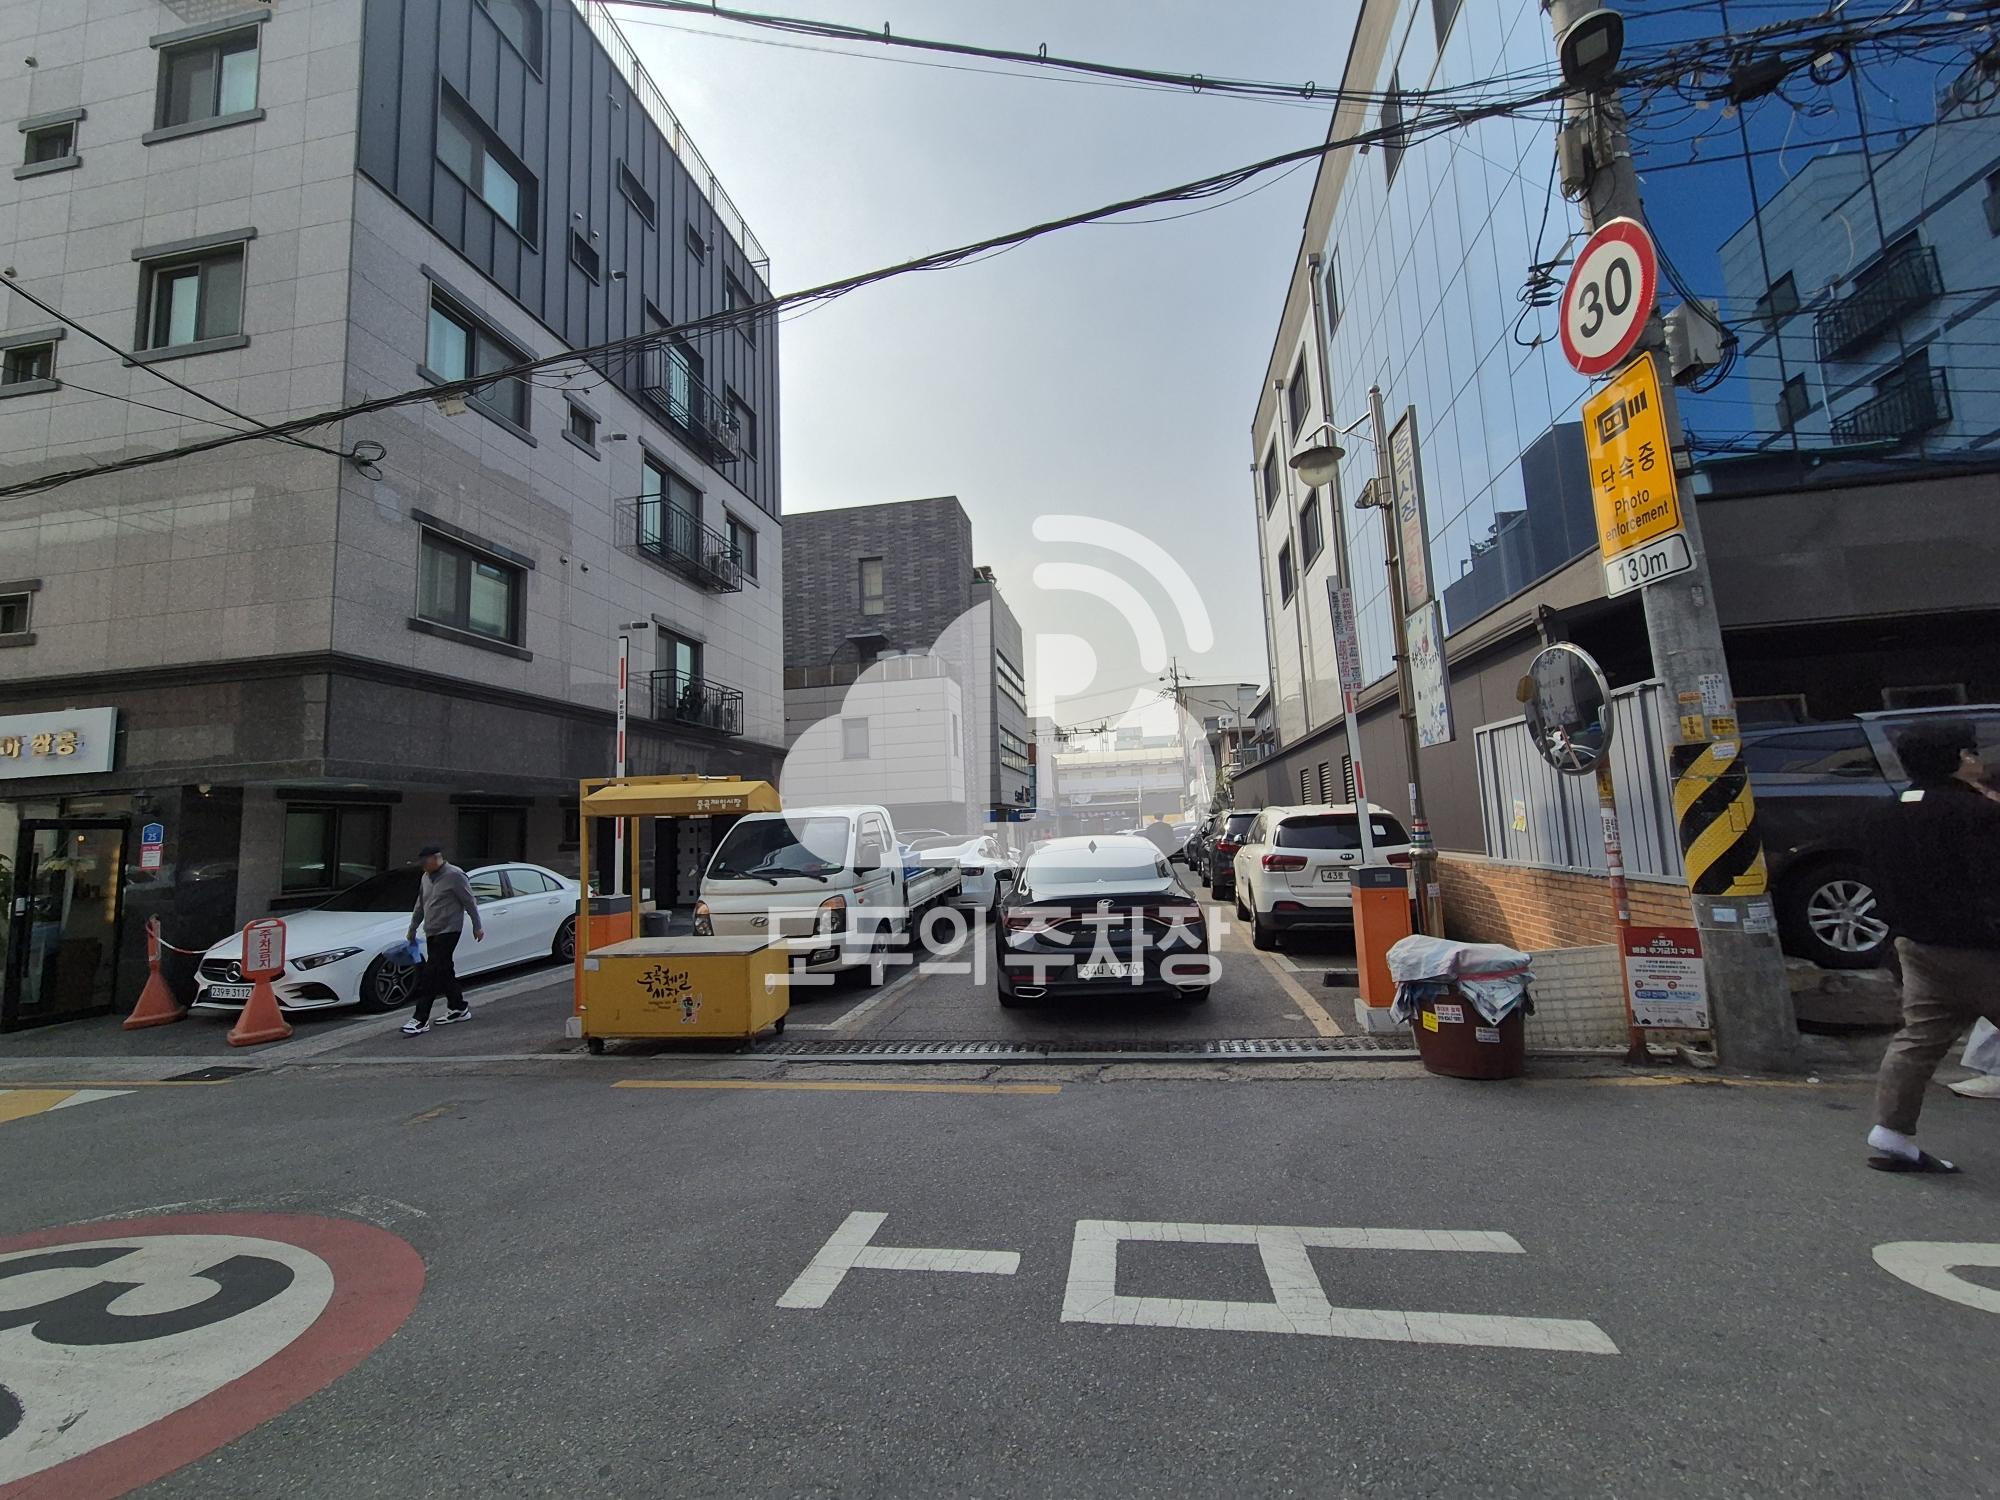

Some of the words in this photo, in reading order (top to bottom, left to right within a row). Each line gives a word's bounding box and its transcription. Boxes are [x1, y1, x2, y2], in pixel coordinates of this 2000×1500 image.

[1578, 257, 1632, 338] 30
[1605, 501, 1669, 540] enforcement
[1614, 489, 1650, 517] Photo
[1617, 550, 1669, 585] 130m
